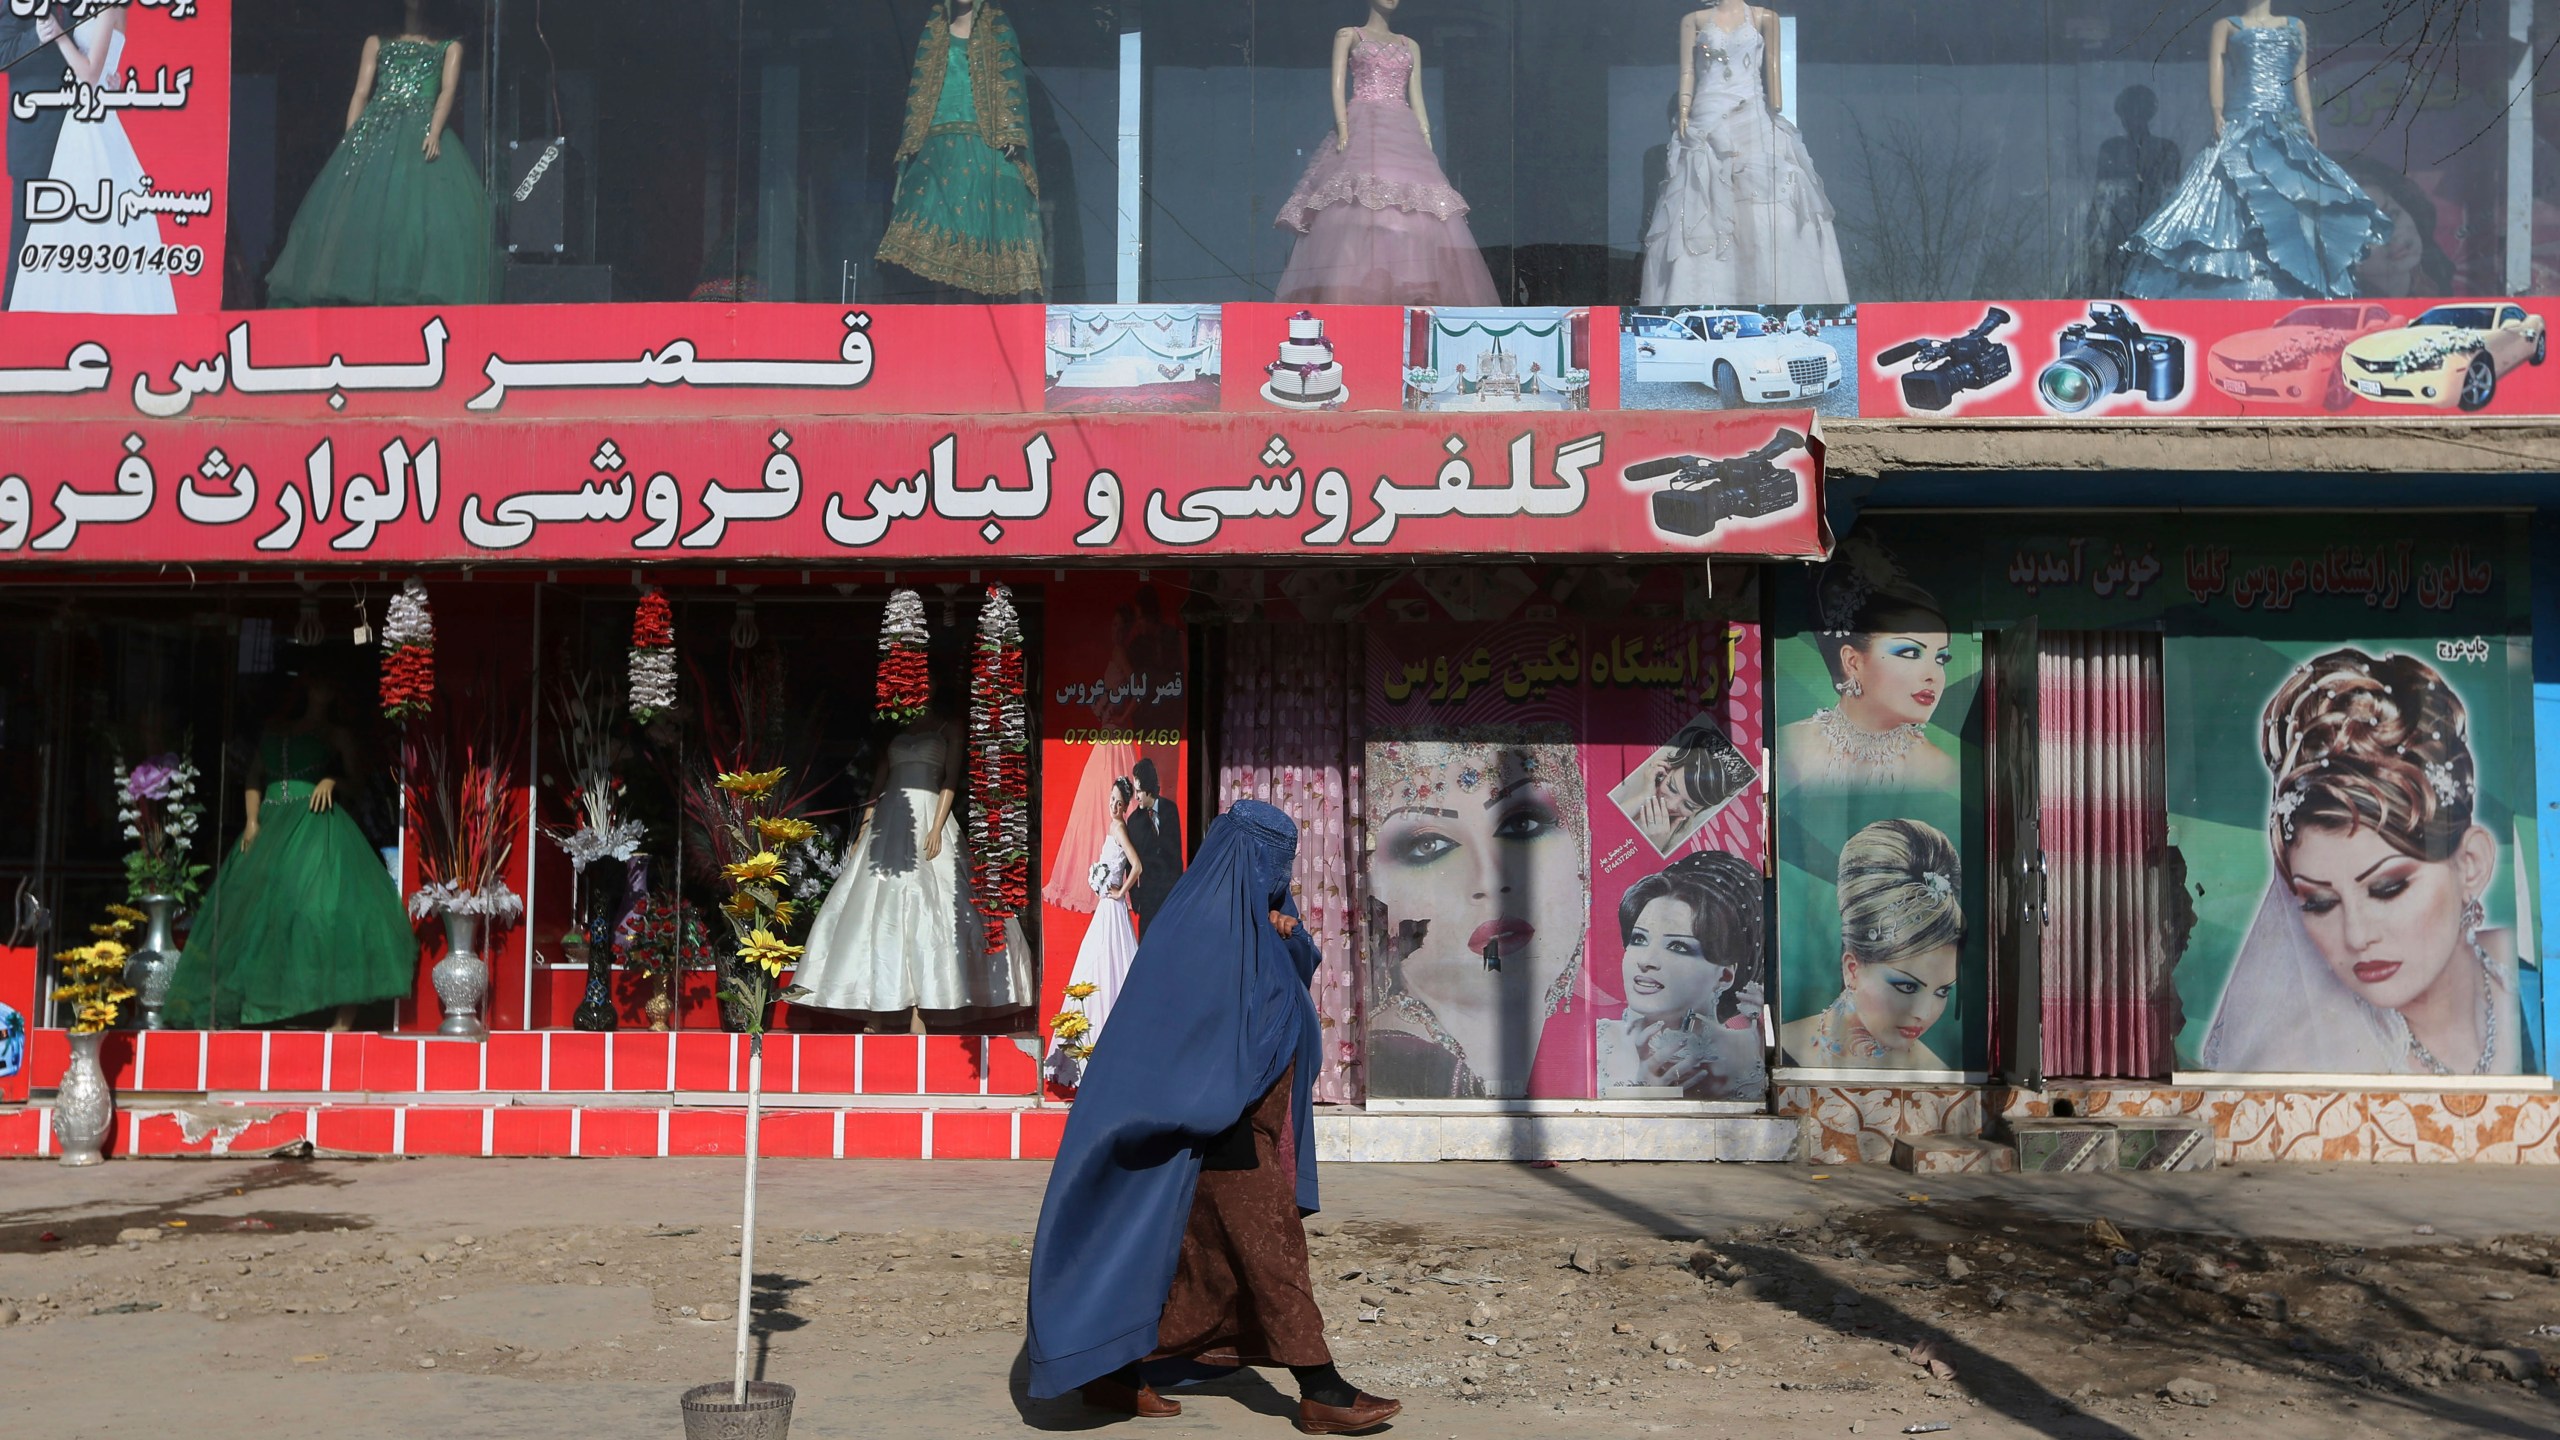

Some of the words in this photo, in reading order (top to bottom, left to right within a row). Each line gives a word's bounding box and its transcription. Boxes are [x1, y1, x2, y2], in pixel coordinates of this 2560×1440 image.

[12, 66, 193, 121] گلفروشی
[24, 180, 111, 222] DJ
[118, 175, 212, 227] سیستم
[19, 243, 204, 276] 0799301469
[132, 316, 450, 417] لباس
[465, 311, 875, 411] قصر
[177, 436, 441, 551] الوارث
[461, 428, 802, 549] فروشی
[823, 432, 1059, 548] لباس
[1074, 468, 1125, 548] و
[1145, 430, 1605, 548] گلفروشی
[2008, 537, 2087, 596] آمدید
[2092, 539, 2163, 600] خوش
[2233, 557, 2307, 610] عروس
[2310, 539, 2414, 609] آرایشگاه
[2417, 544, 2493, 610] صالون
[1384, 646, 1492, 702] عروس
[1503, 632, 1580, 699] نگین
[1590, 629, 1743, 700] آرایشگاه
[2466, 635, 2490, 663] چاپ
[1056, 678, 1105, 704] عروس
[1109, 672, 1148, 704] لباس
[1152, 672, 1183, 704] قصر
[1064, 728, 1181, 746] 0799301469
